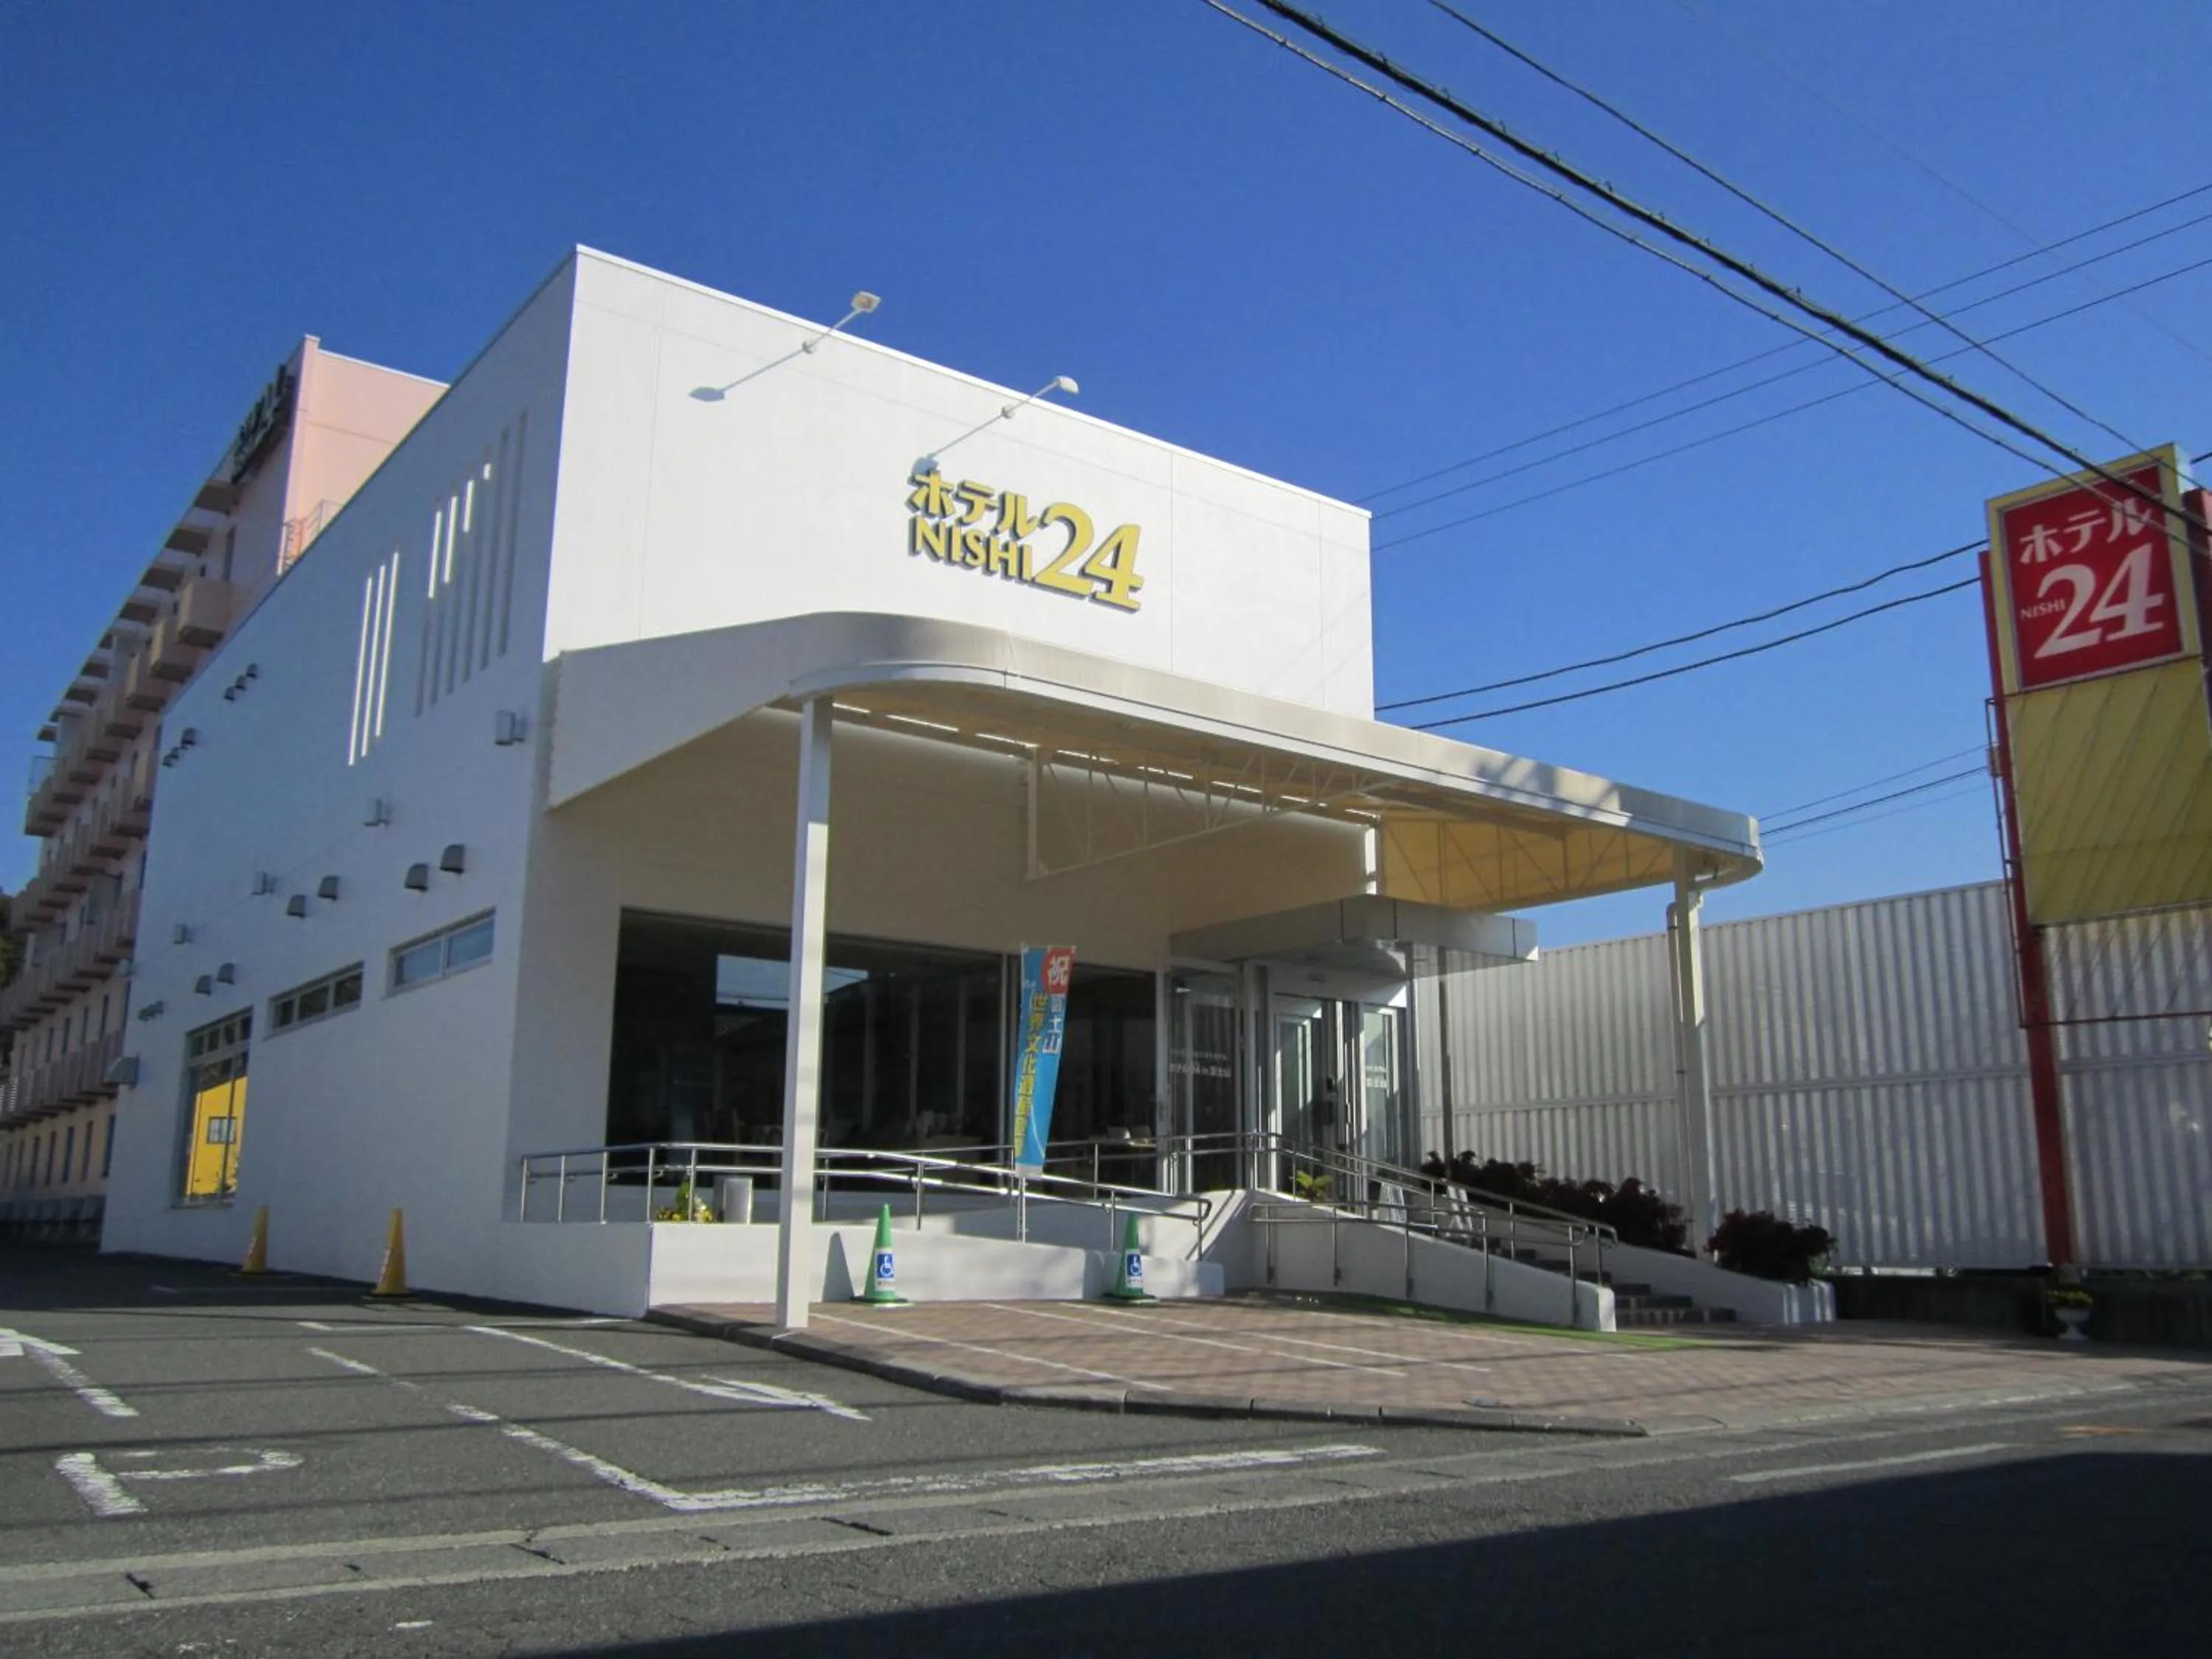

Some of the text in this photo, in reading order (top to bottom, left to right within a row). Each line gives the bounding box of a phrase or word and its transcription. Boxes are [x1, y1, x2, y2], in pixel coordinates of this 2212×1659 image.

[905, 470, 1038, 541] ホテル
[2019, 497, 2153, 565] ホテル
[908, 501, 1144, 613] NISHI 24
[2020, 542, 2165, 659] NISHI 24
[1047, 956, 1069, 987] 祝
[1042, 994, 1065, 1054] 富士山
